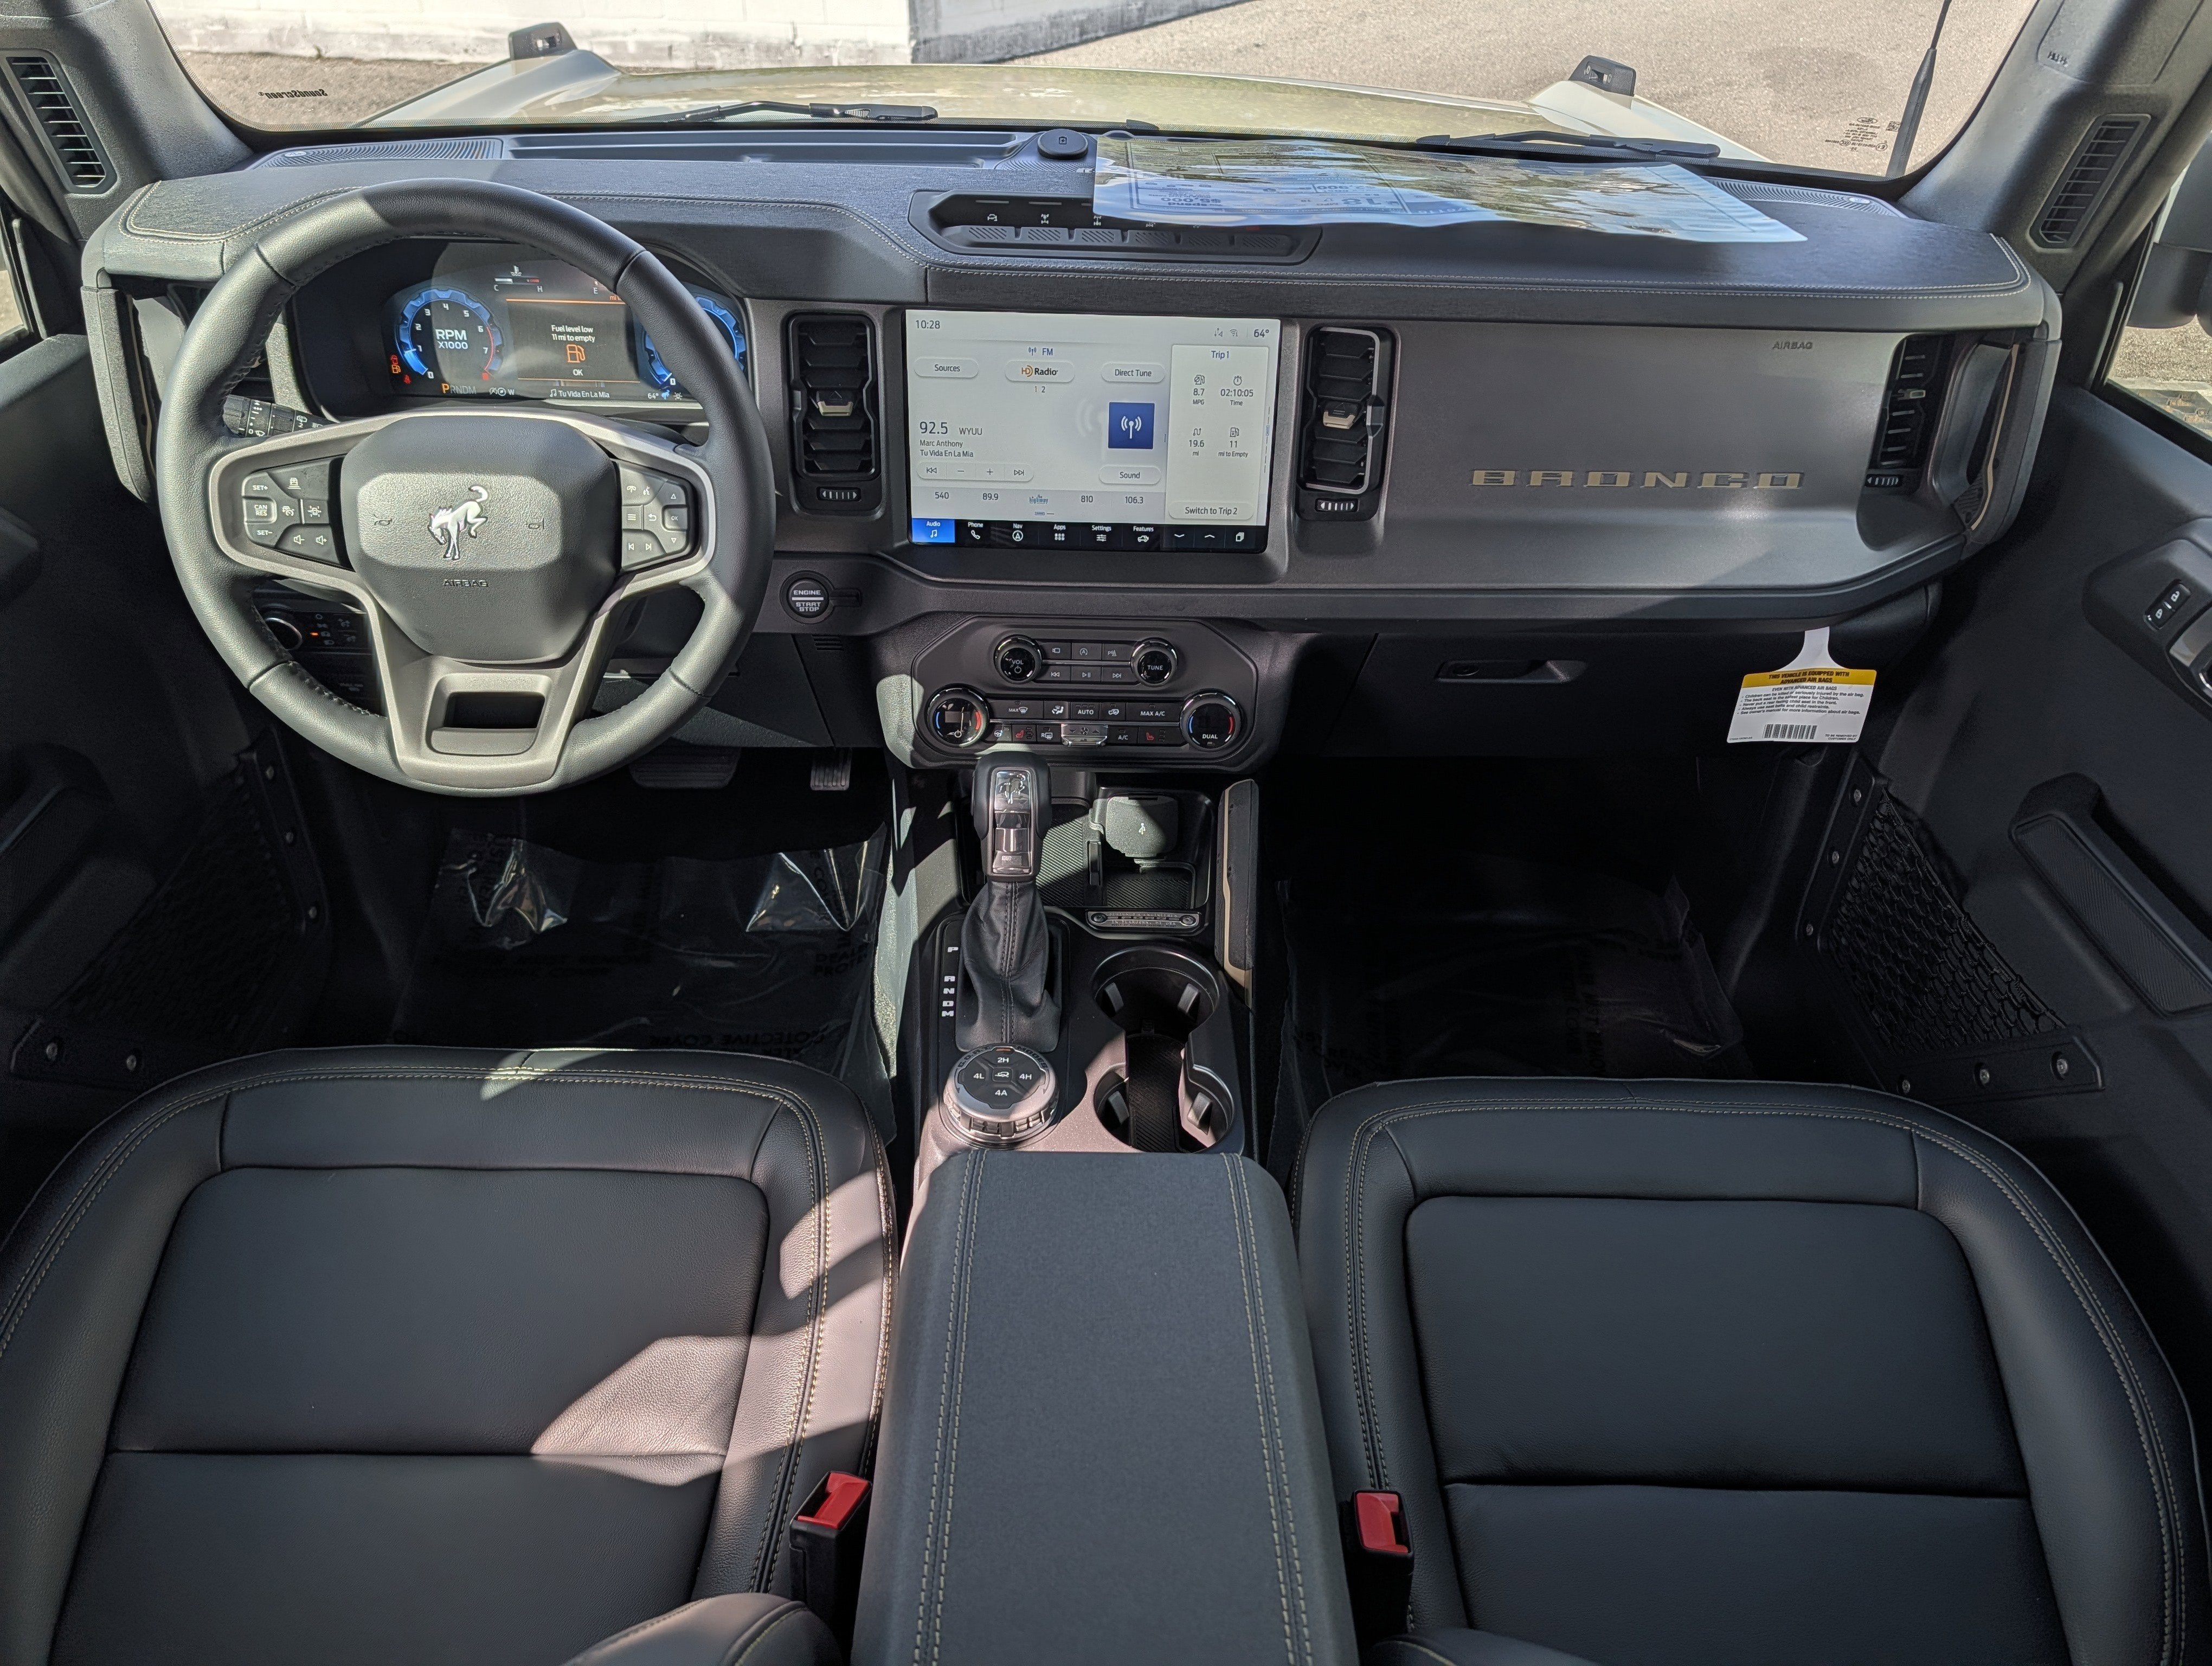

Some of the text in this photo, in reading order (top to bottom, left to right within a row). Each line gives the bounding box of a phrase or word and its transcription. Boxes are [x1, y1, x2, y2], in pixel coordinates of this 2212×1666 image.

[425, 308, 432, 316] 3
[916, 320, 941, 329] 10:28
[435, 329, 468, 341] RPM
[1253, 329, 1270, 338] 64°
[417, 344, 423, 353] 1
[438, 341, 468, 350] X1000
[1772, 341, 1813, 349] AIRBAG
[1211, 350, 1225, 360] Trip
[427, 371, 434, 379] 0
[1220, 389, 1253, 397] 02:10:05
[919, 421, 948, 434] 92.5
[959, 427, 983, 435] WYUU
[1470, 470, 1805, 489] BRONCO
[1219, 507, 1232, 516] Trip
[442, 579, 489, 588] AIRBAG
[1016, 1046, 1048, 1068] MODES
